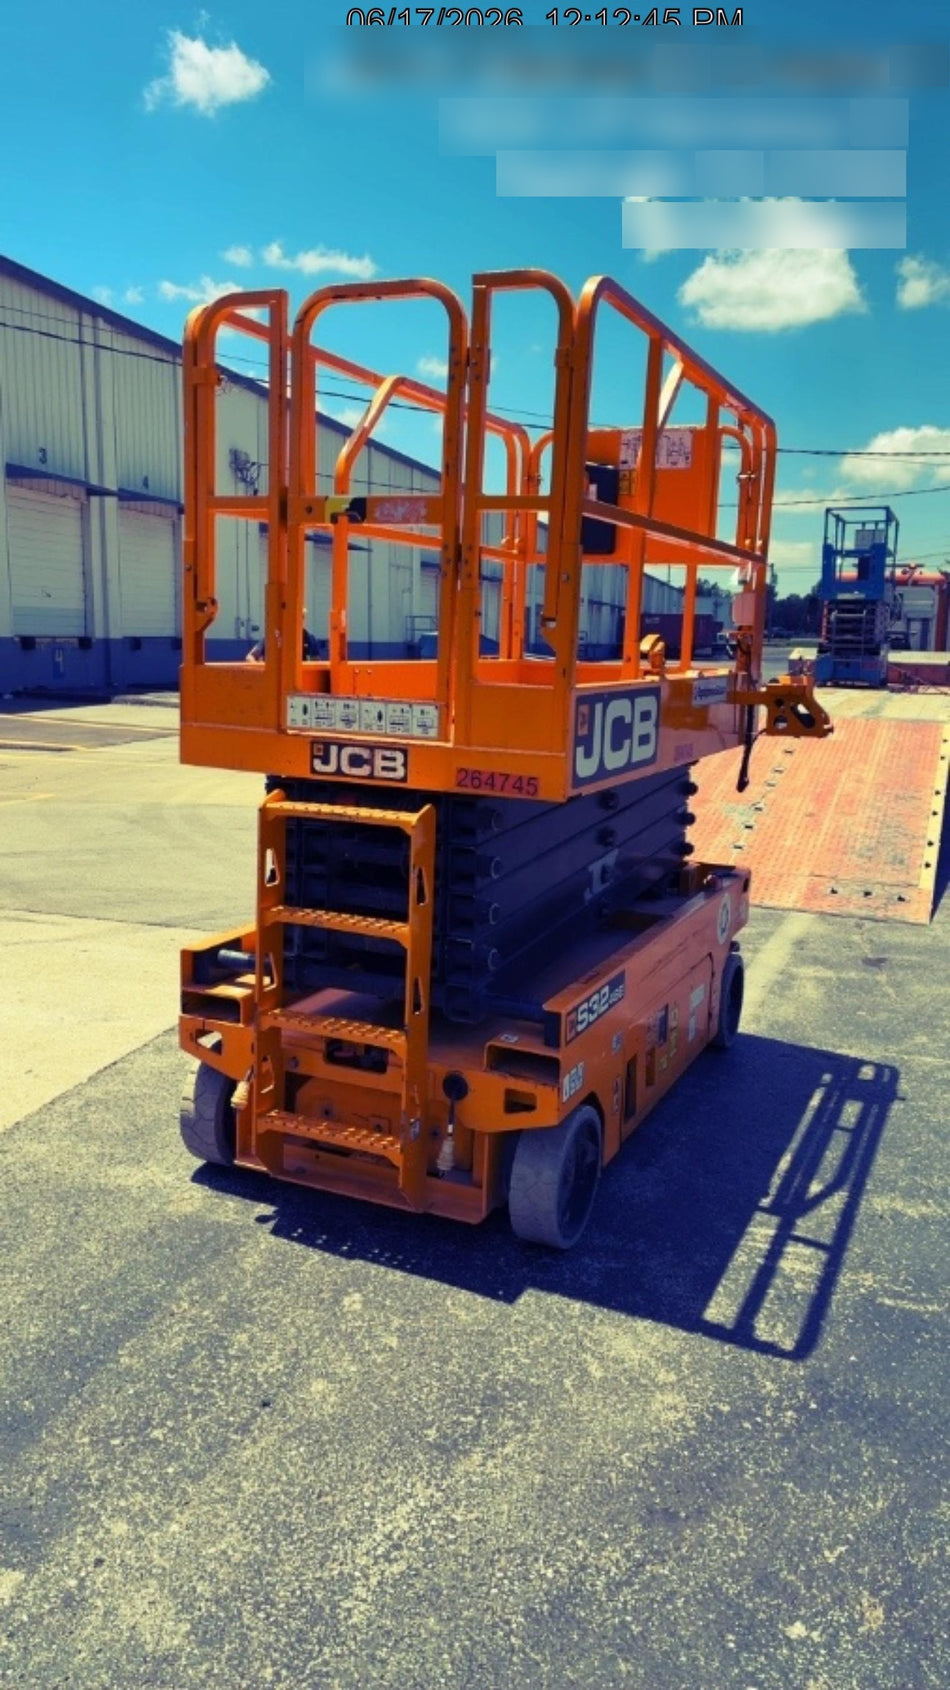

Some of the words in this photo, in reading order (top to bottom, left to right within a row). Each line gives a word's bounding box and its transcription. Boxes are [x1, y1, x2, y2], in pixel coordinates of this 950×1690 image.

[39, 448, 47, 464] 3
[576, 696, 657, 778] JCB
[312, 745, 406, 779] JCB
[456, 768, 538, 796] 264745
